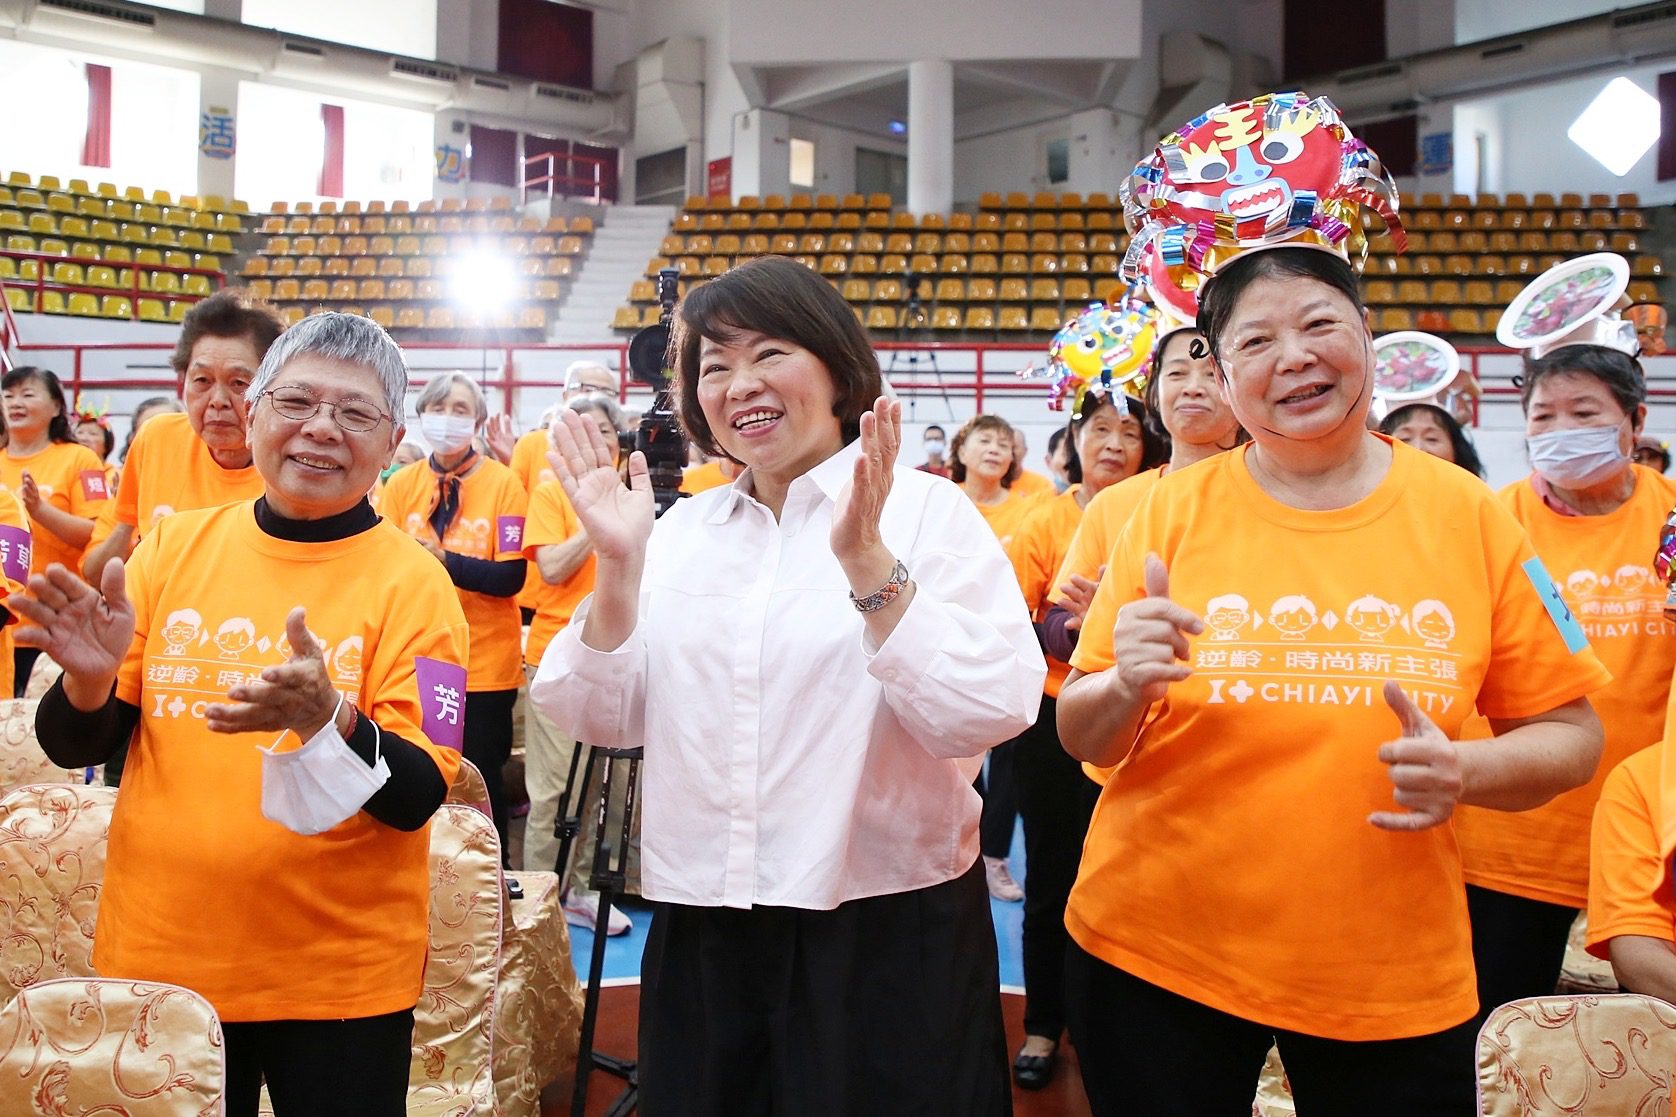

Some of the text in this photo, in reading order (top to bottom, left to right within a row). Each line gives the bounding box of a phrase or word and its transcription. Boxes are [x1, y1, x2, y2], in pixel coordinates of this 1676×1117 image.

[202, 113, 234, 148] 活
[504, 525, 521, 543] 芳
[1581, 621, 1640, 637] HIAYI
[433, 683, 460, 725] 芳
[1260, 682, 1374, 707] CHIAYI
[1401, 689, 1455, 715] ITY
